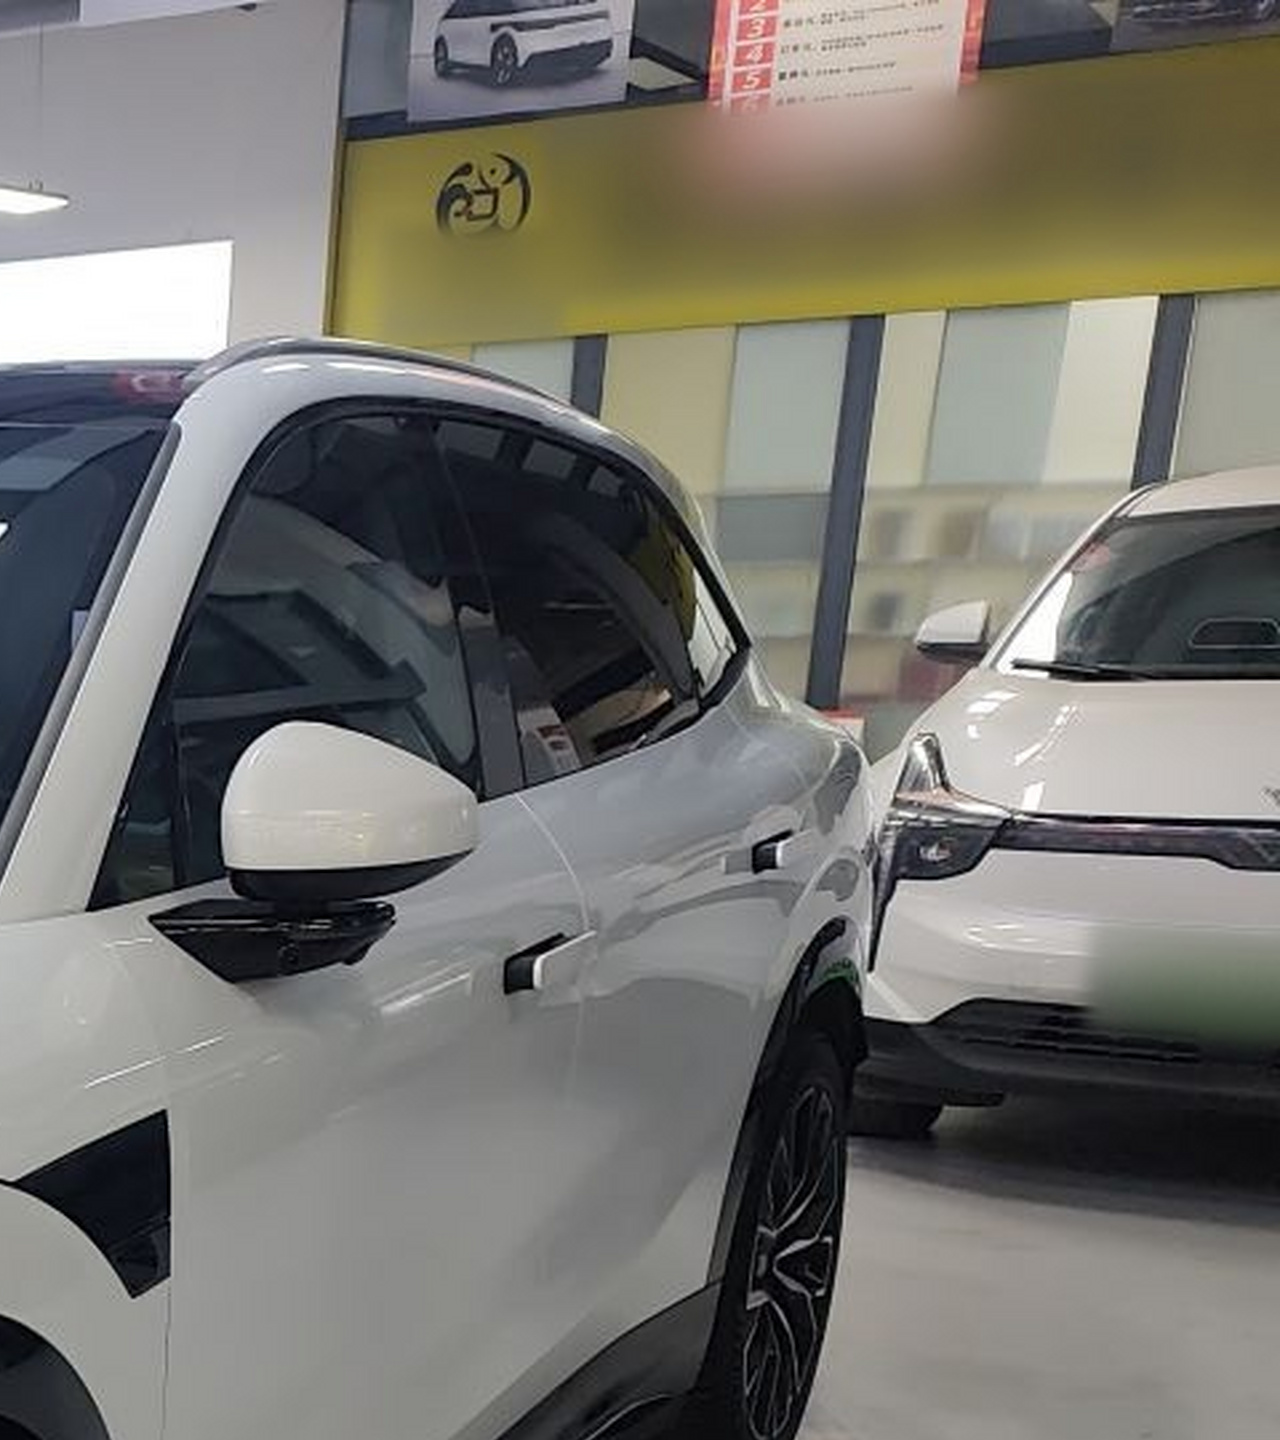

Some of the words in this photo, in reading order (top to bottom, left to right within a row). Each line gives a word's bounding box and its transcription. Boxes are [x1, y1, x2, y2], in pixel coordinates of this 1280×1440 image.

[747, 18, 766, 38] 3
[746, 44, 763, 62] 4
[742, 70, 761, 89] 5
